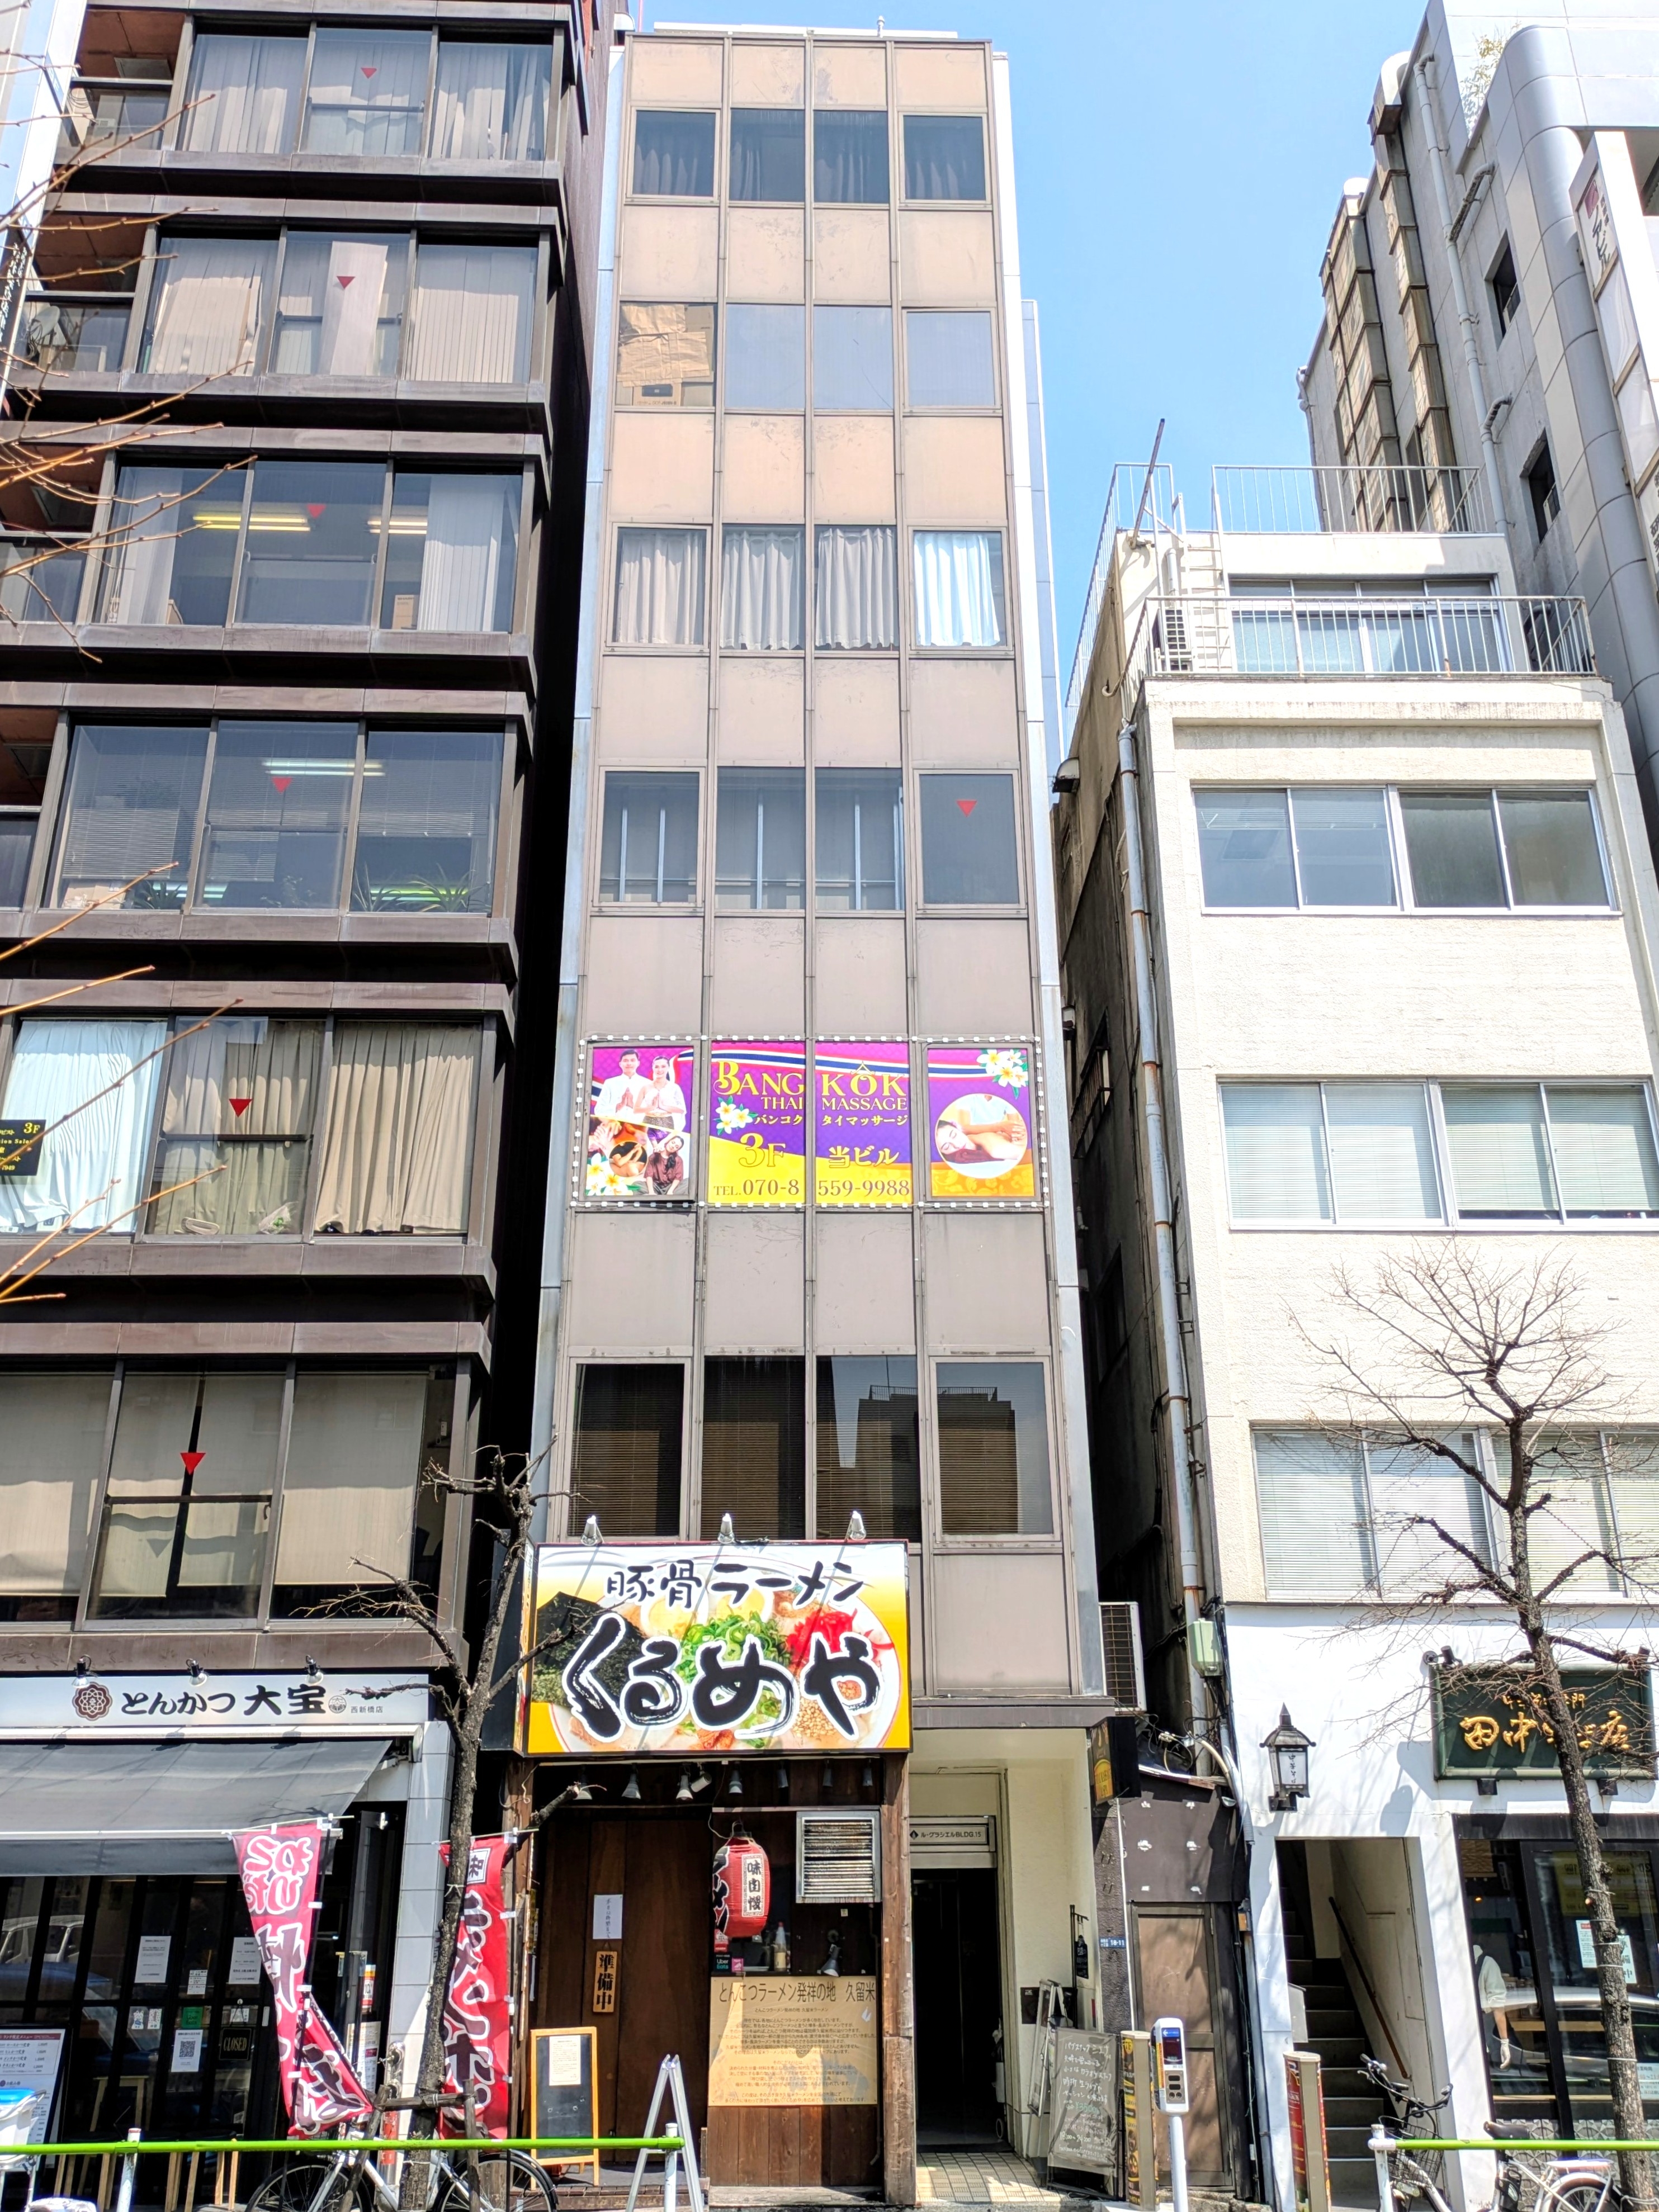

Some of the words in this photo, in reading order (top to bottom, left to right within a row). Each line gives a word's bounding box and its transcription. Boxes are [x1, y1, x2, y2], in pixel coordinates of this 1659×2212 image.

[760, 1097, 803, 1110] THAI
[821, 1097, 908, 1111] MASSAGE
[23, 1122, 41, 1134] 3F
[738, 1132, 786, 1168] 3F
[828, 1145, 900, 1169] 当ビル
[606, 1559, 864, 1609] 豚骨ラーメン
[564, 1614, 881, 1740] くるめや
[351, 1706, 384, 1714] 西新橋店
[596, 1954, 615, 2011] 準備中
[845, 1981, 876, 2002] 久留米
[224, 2037, 247, 2052] CLOSED
